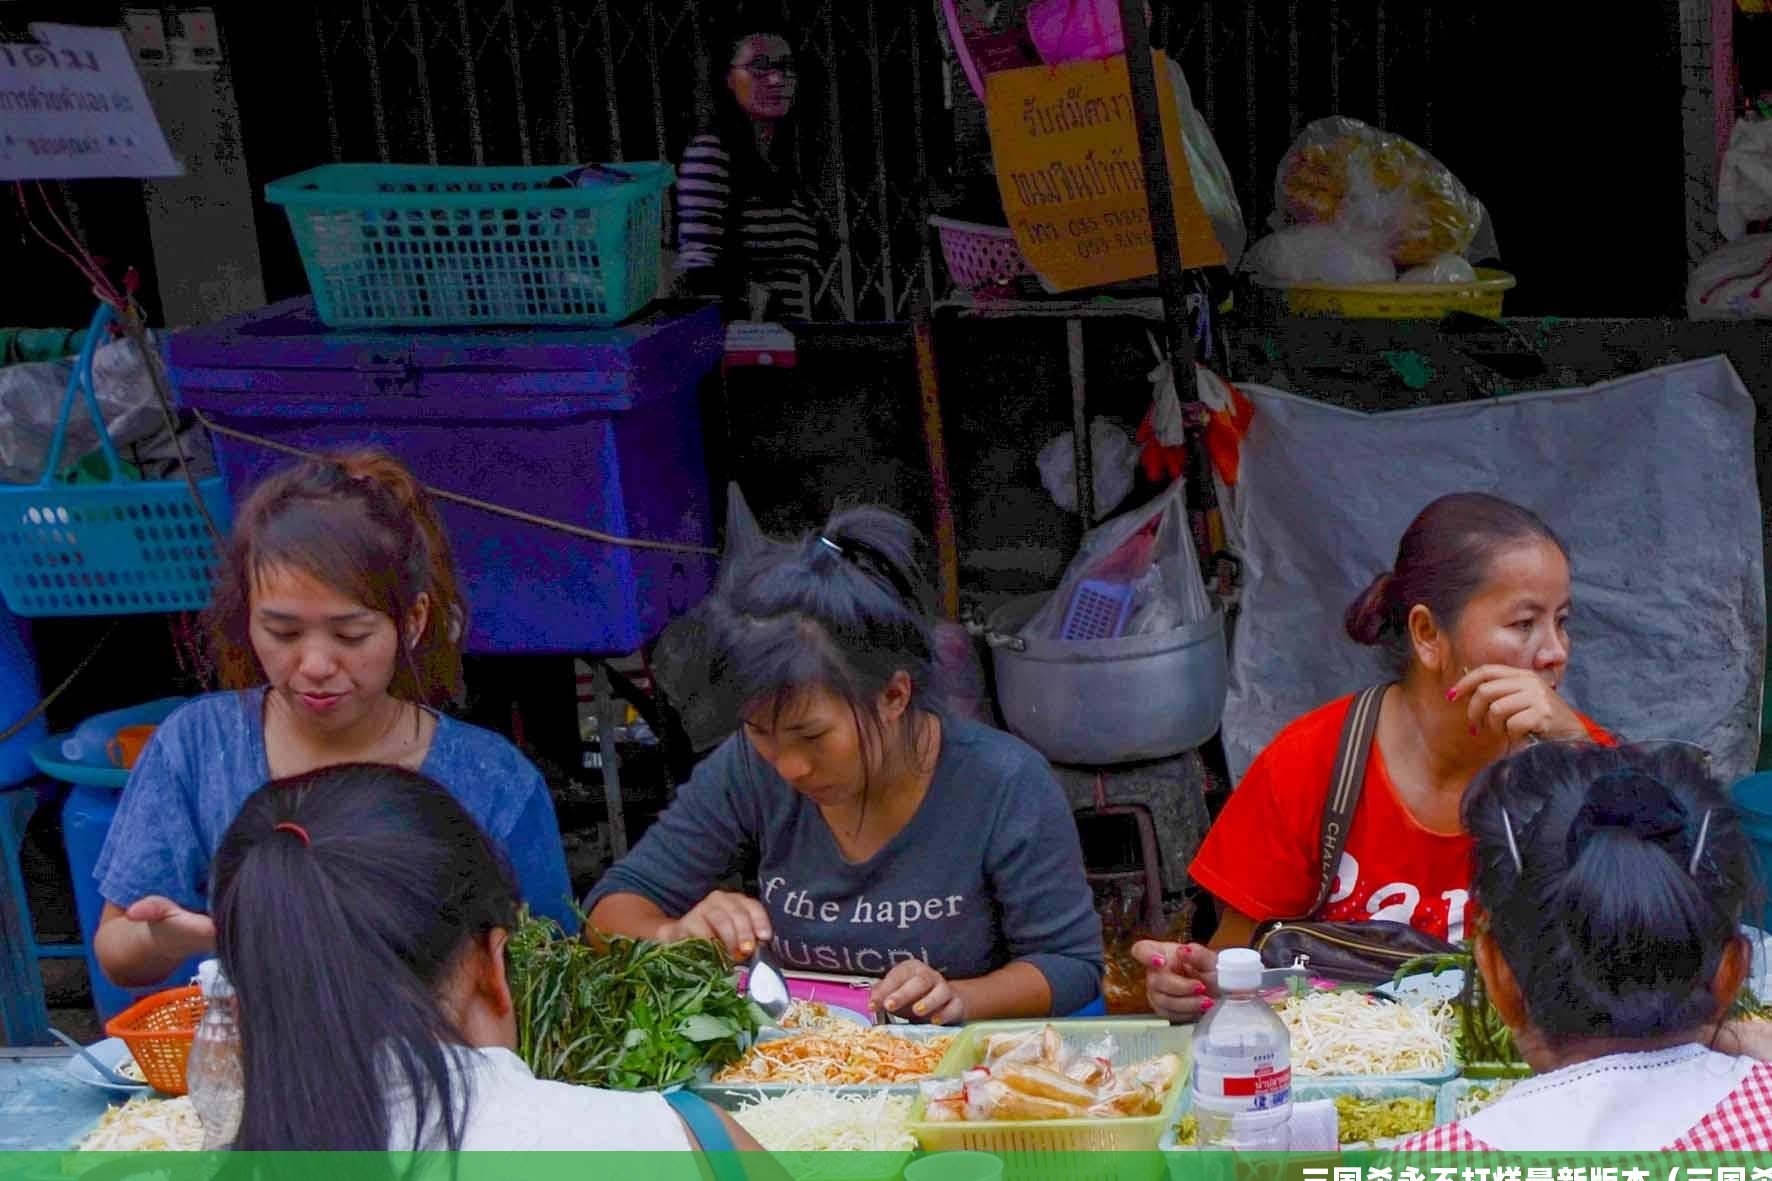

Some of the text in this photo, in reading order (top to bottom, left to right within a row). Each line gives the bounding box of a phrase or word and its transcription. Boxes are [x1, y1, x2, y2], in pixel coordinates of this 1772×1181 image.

[759, 876, 963, 929] f the haper
